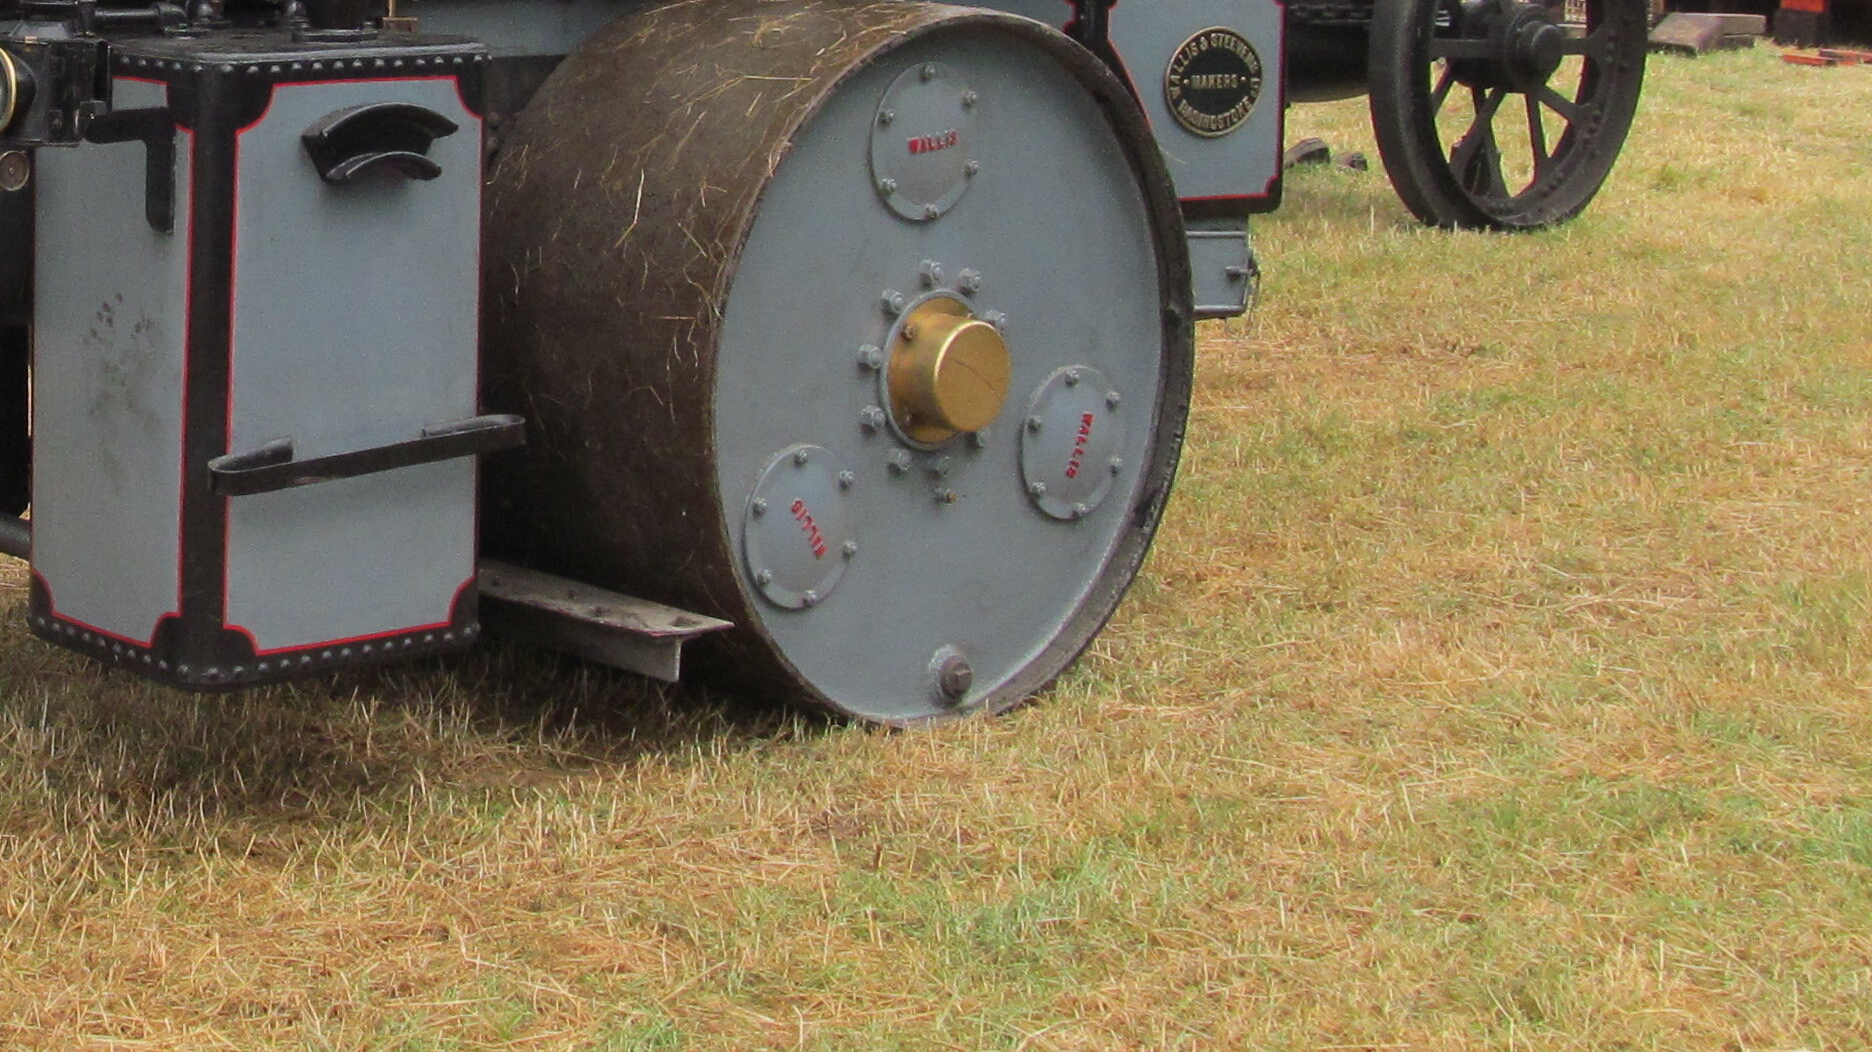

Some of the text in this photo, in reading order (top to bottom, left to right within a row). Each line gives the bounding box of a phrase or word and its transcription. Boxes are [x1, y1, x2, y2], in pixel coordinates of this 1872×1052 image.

[1169, 42, 1200, 100] WALLIS
[1190, 74, 1239, 90] MAKERS
[907, 131, 958, 154] WALLIS
